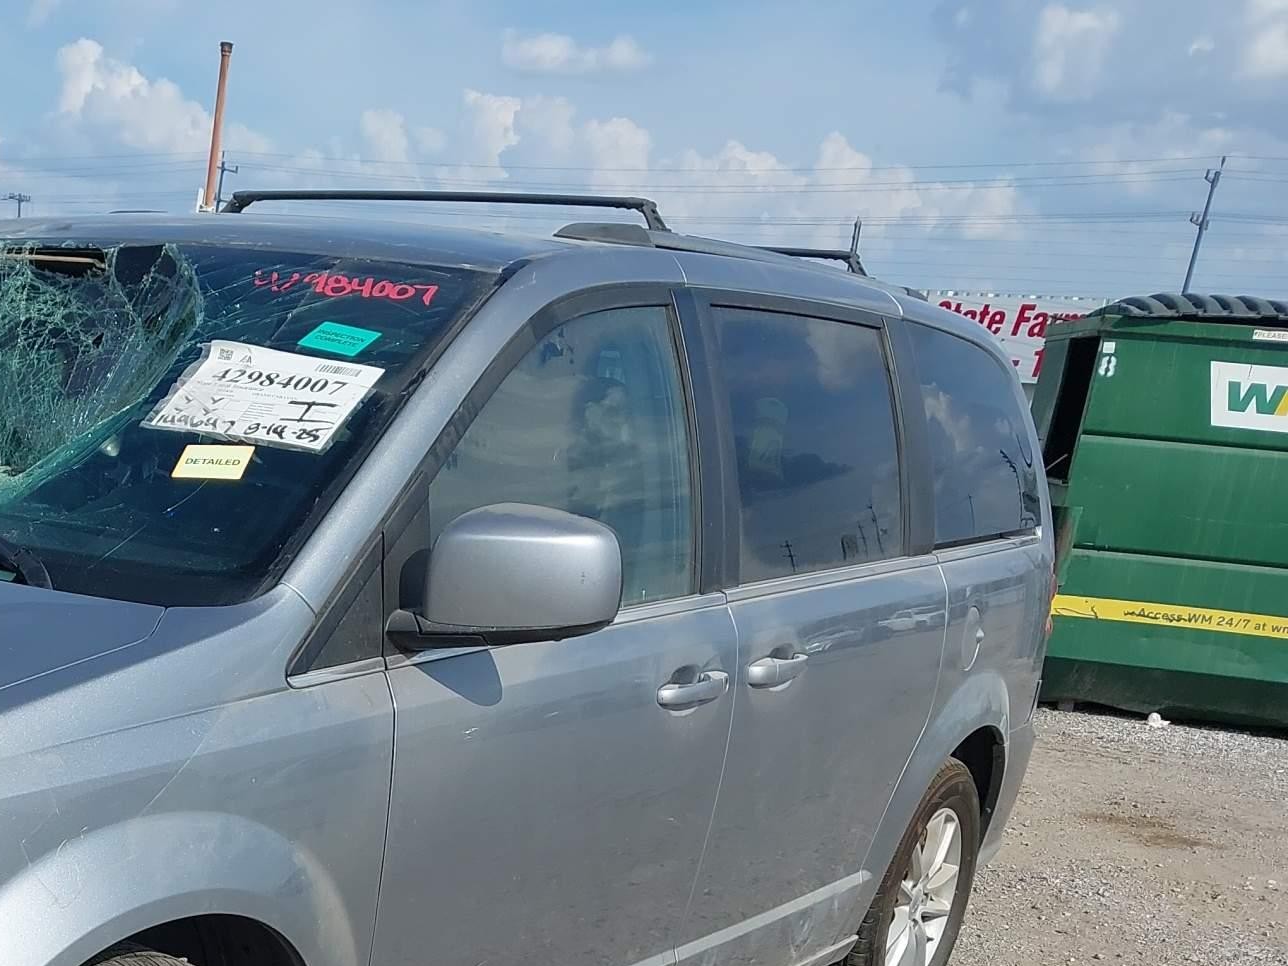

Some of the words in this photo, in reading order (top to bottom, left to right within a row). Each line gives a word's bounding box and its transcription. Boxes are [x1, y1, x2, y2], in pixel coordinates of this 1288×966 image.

[314, 334, 360, 348] COMPLETE
[317, 328, 366, 343] INSPECTION
[212, 367, 348, 397] 42984007
[184, 458, 241, 466] DETAILED
[1138, 607, 1183, 623] Access
[1188, 612, 1212, 625] WM
[1216, 616, 1251, 630] 24/7
[1254, 622, 1268, 632] at
